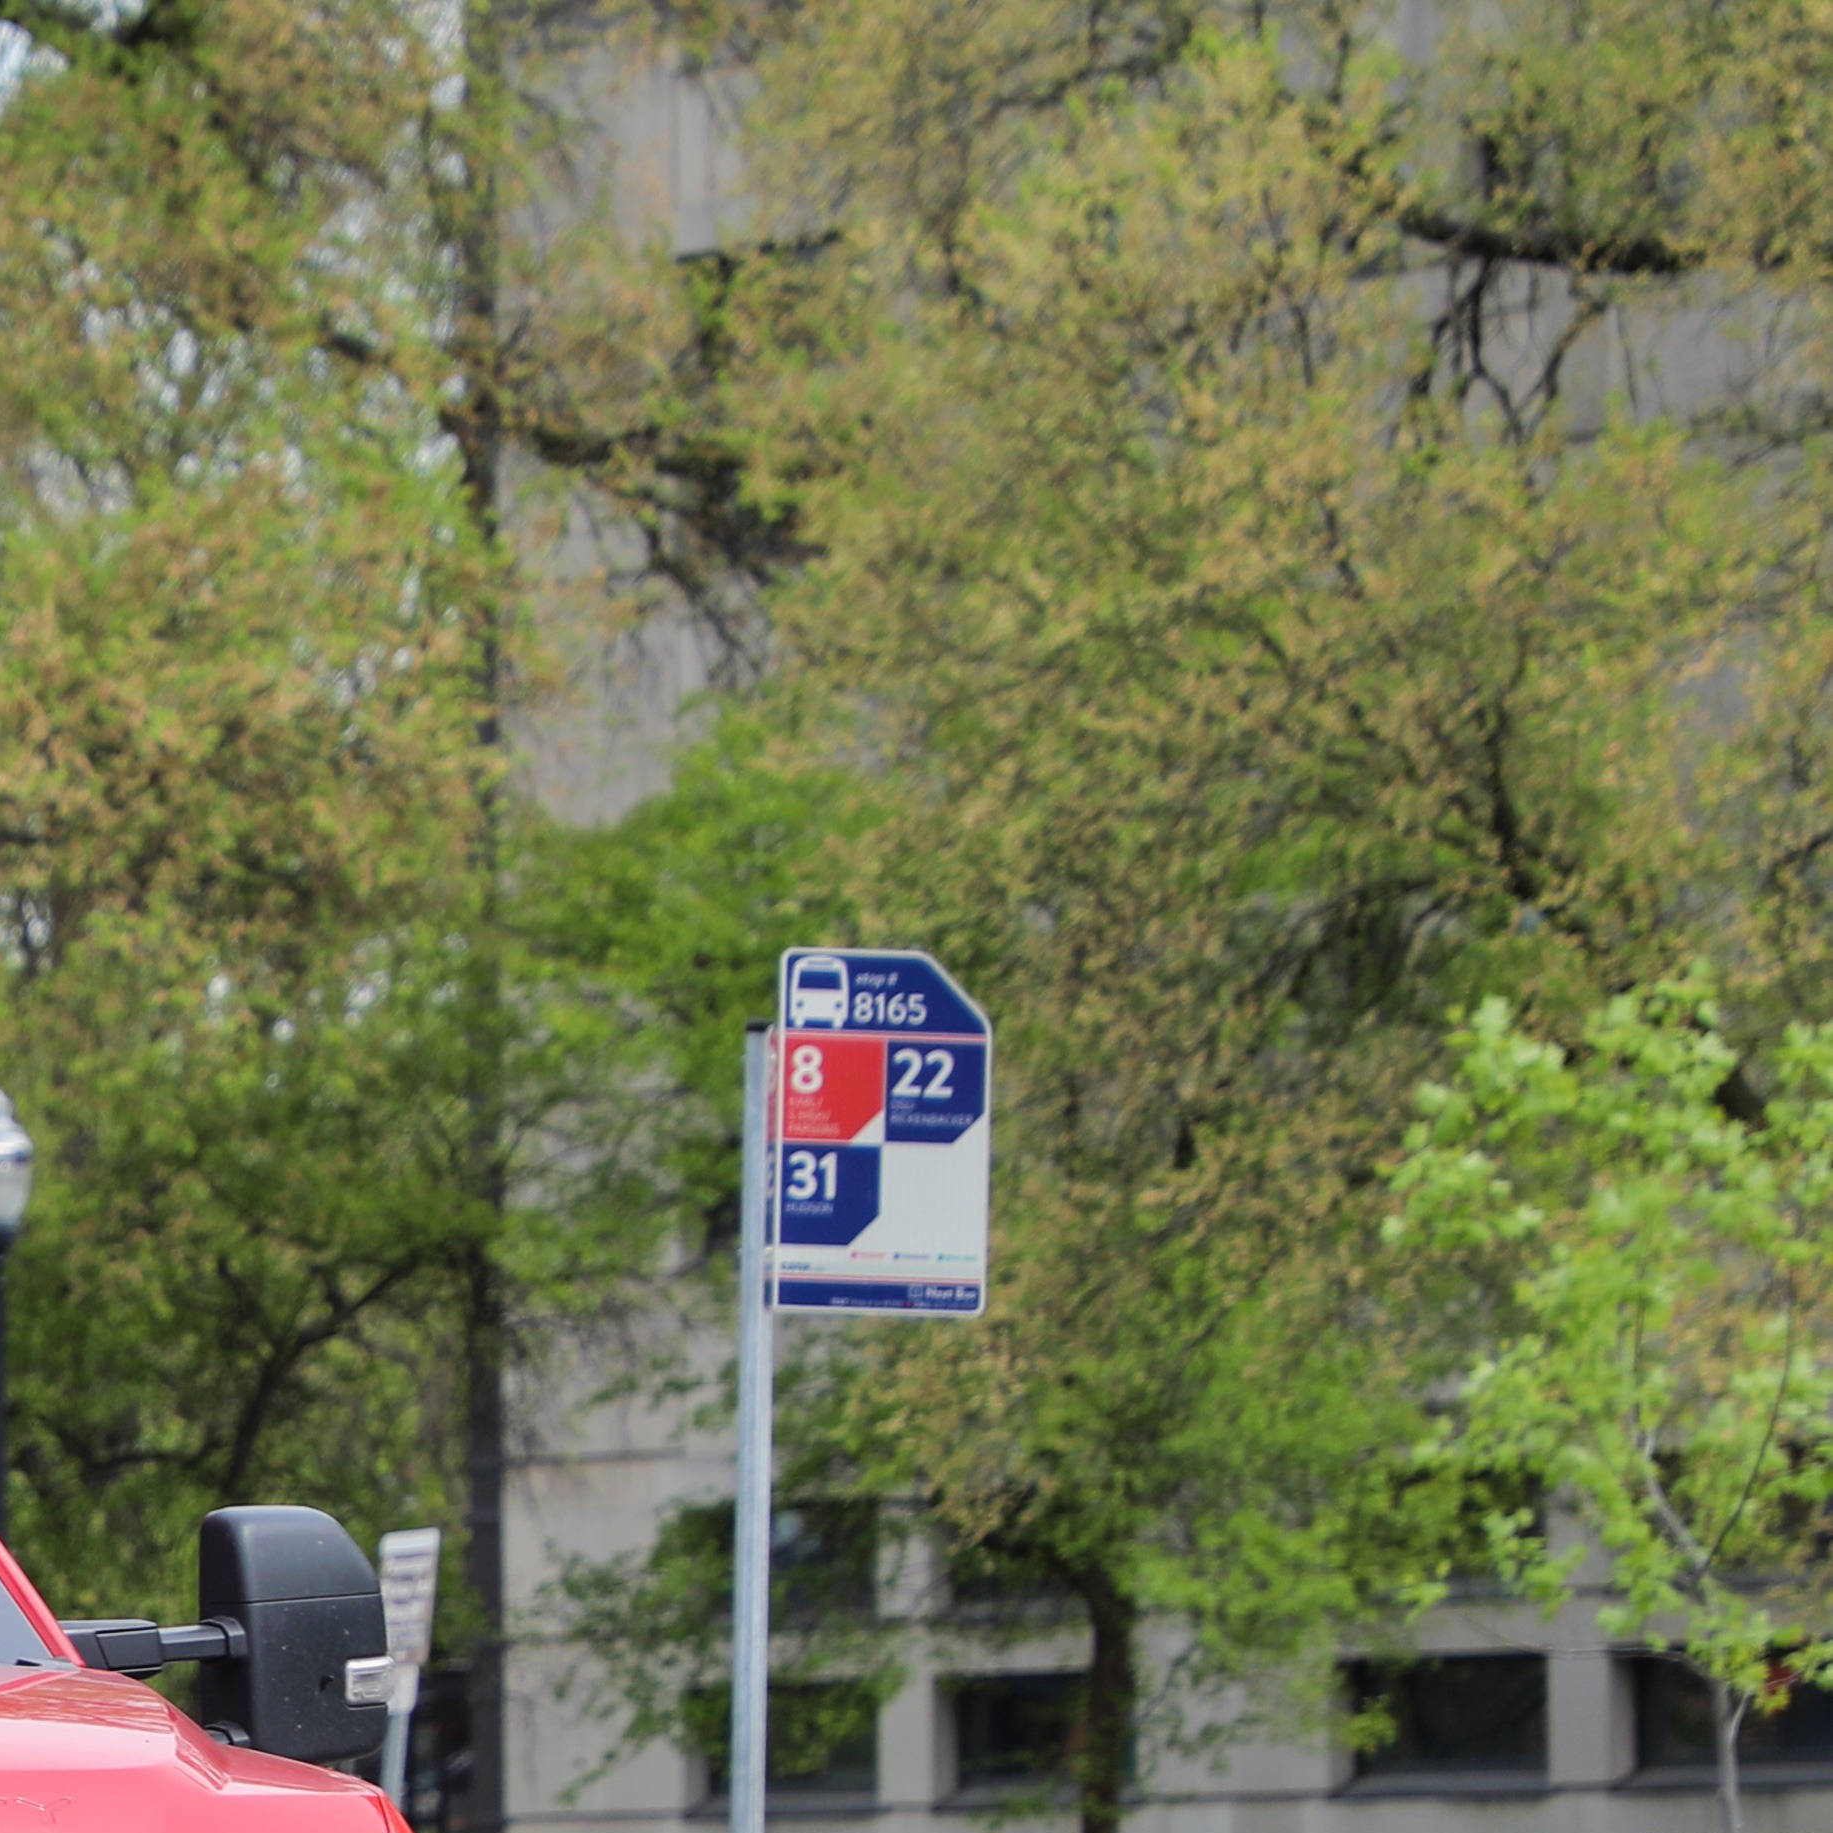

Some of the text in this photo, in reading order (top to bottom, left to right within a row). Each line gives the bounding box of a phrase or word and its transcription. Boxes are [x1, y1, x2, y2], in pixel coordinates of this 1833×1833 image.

[853, 990, 929, 1026] 8165
[790, 1044, 825, 1095] 8
[890, 1047, 955, 1099] 22
[786, 1149, 838, 1200] 31
